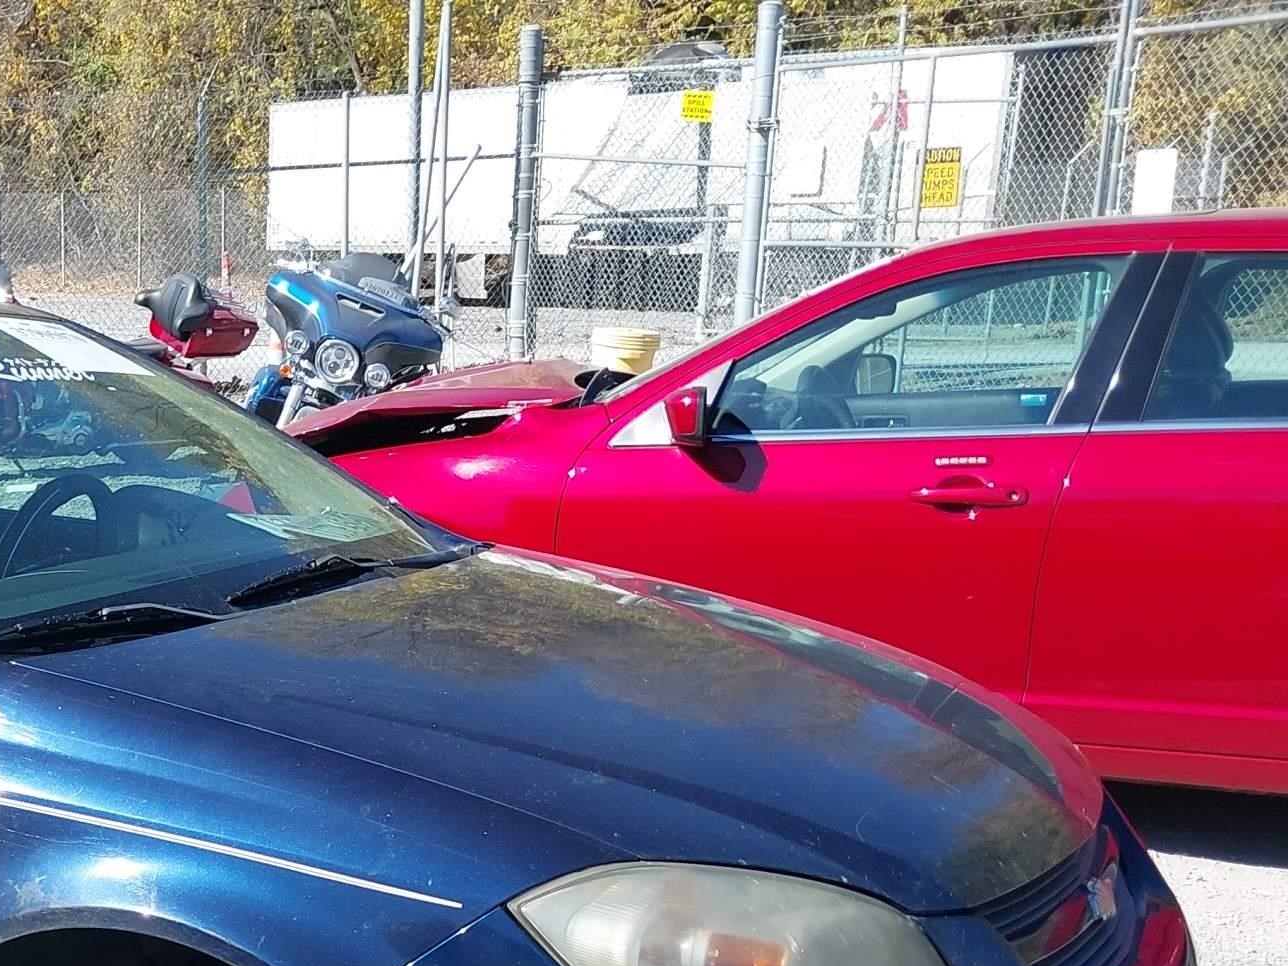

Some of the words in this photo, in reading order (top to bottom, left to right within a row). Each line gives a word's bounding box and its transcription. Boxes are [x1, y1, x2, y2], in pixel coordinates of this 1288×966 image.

[927, 167, 954, 178] PEED
[925, 179, 955, 190] UMPS
[924, 191, 953, 202] HEAD
